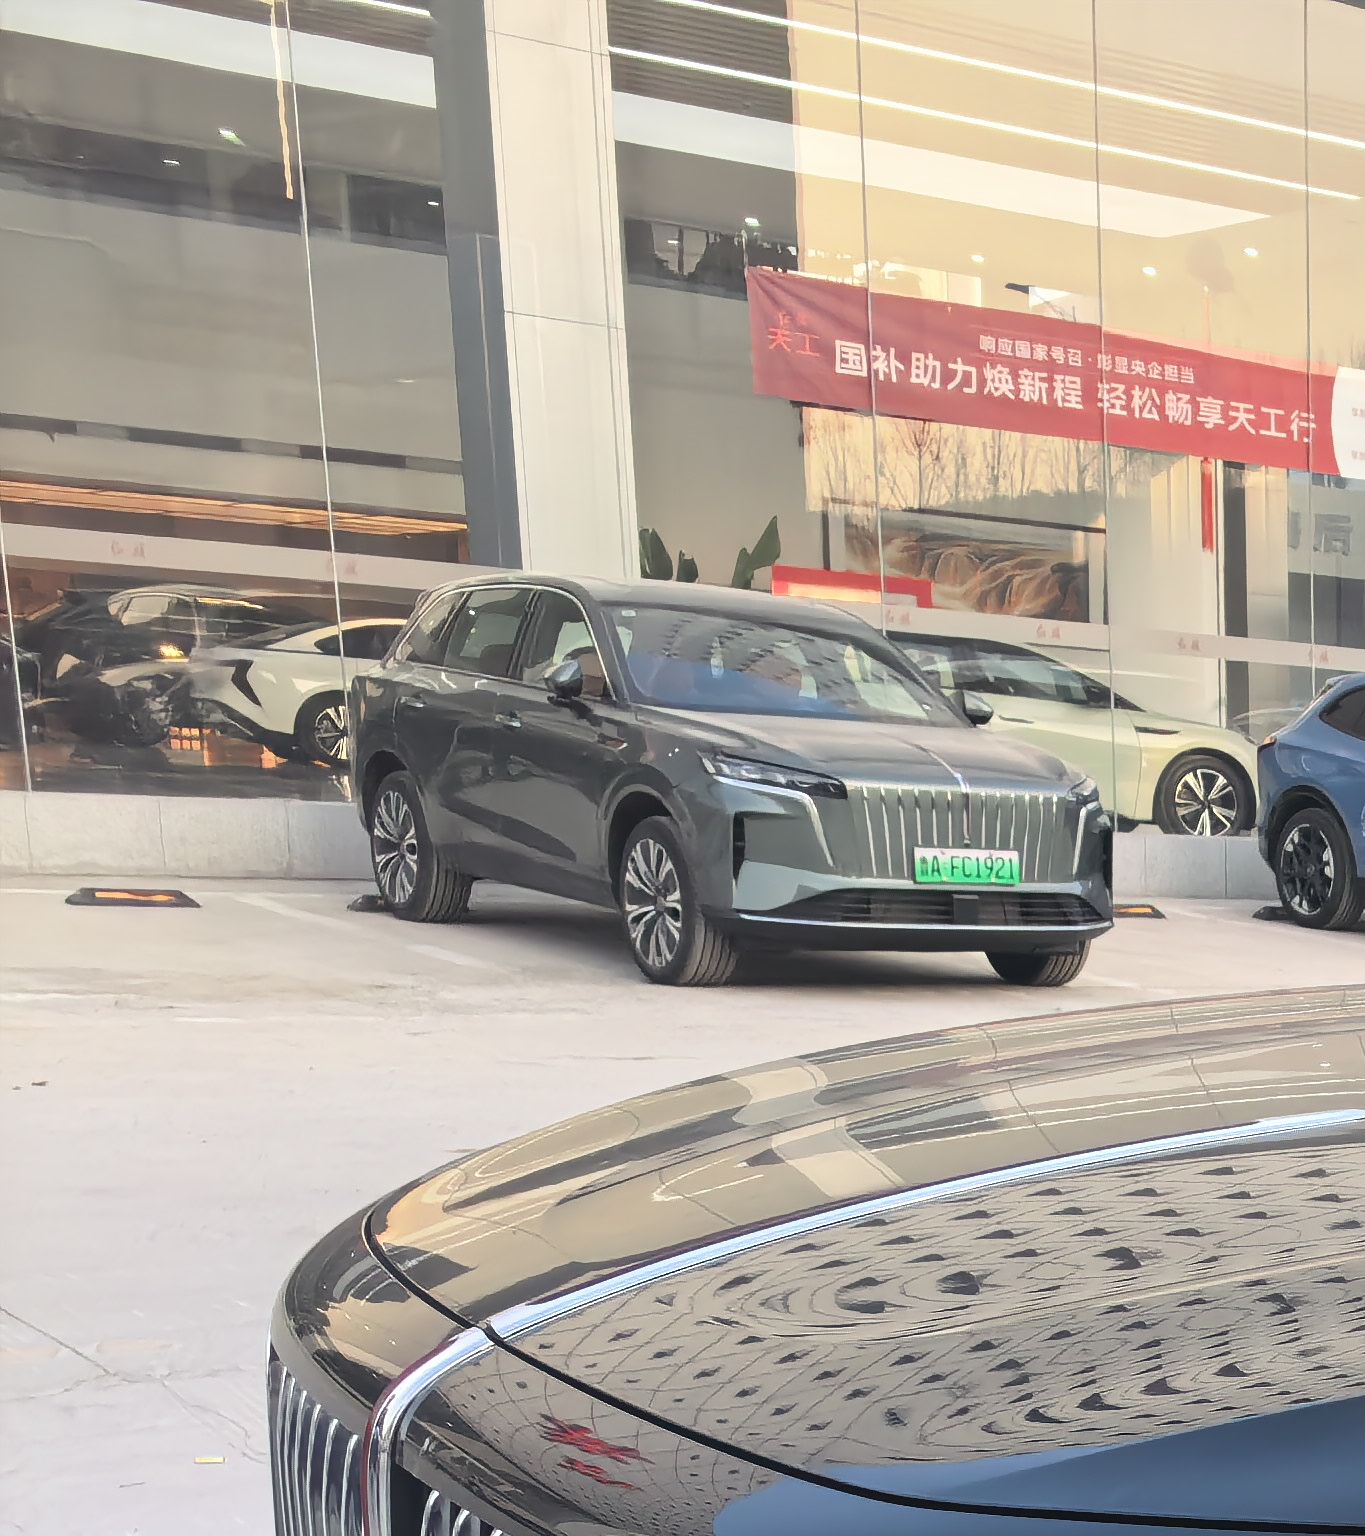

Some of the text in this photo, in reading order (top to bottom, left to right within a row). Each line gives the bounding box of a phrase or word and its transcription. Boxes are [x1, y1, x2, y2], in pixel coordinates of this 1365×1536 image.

[834, 339, 1317, 443] 国补助力焕新程 轻松畅享天工行
